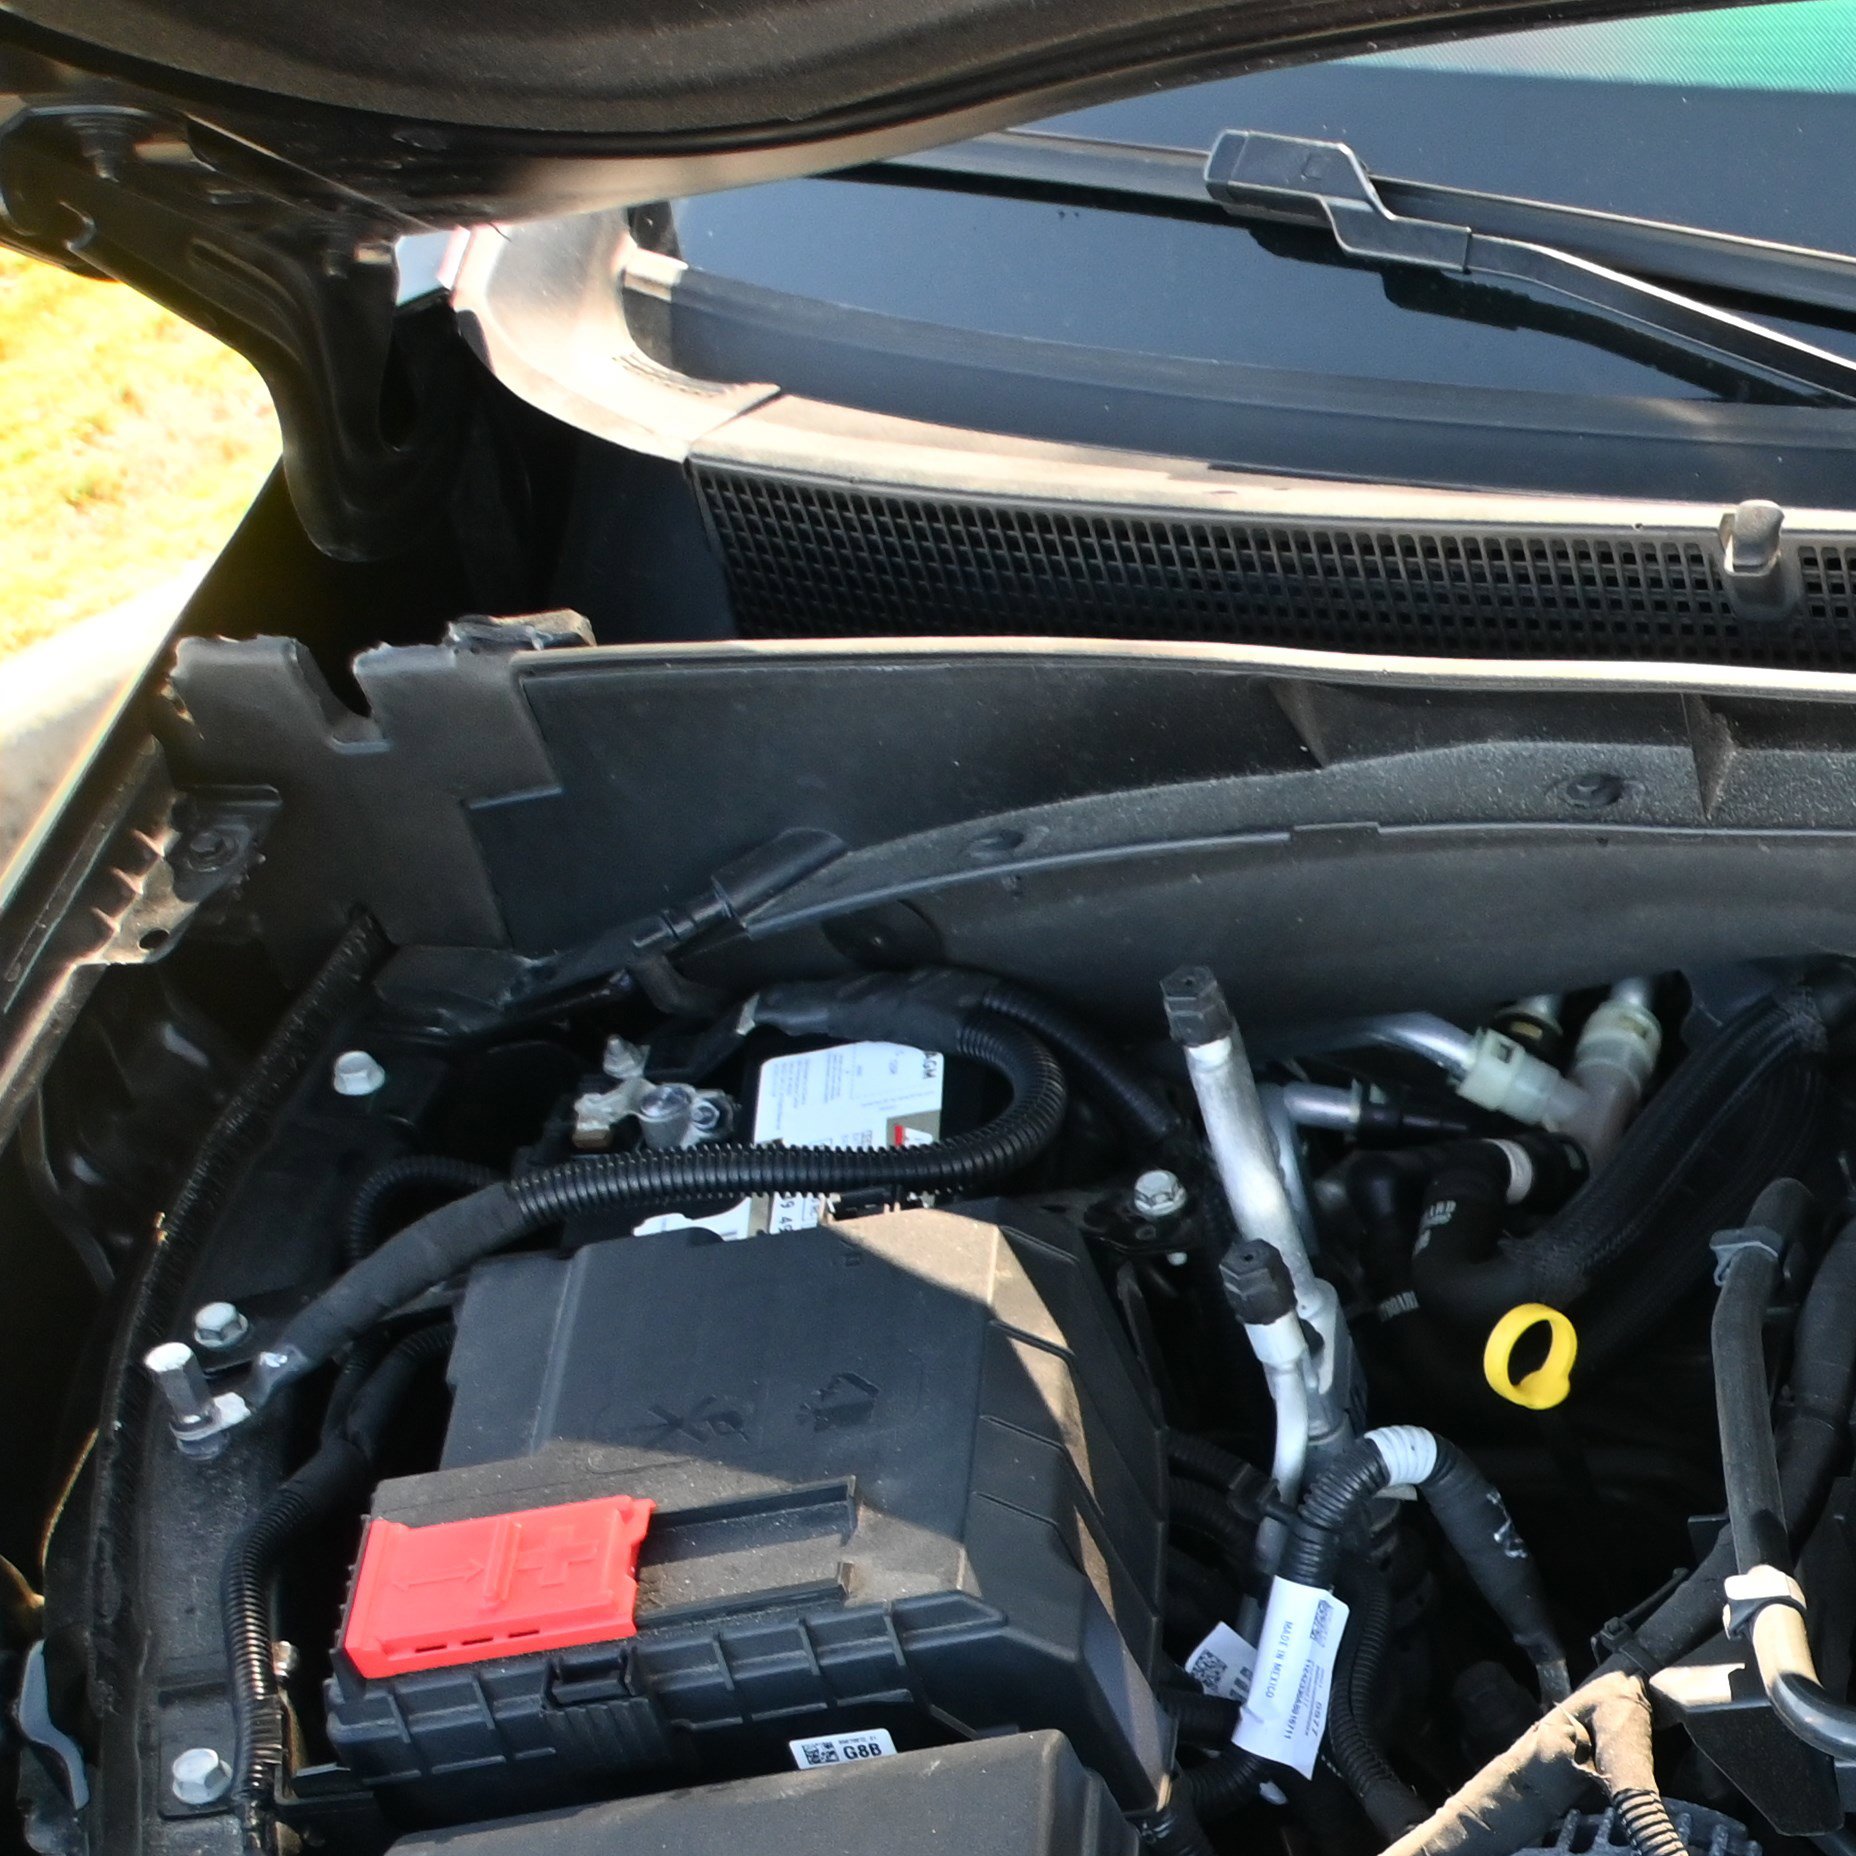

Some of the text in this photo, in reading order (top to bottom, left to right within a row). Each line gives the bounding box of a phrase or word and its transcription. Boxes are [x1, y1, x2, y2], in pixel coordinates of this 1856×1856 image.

[1279, 1620, 1294, 1649] MADE
[1265, 1662, 1282, 1700] MEXICO
[843, 1742, 882, 1760] G8B
